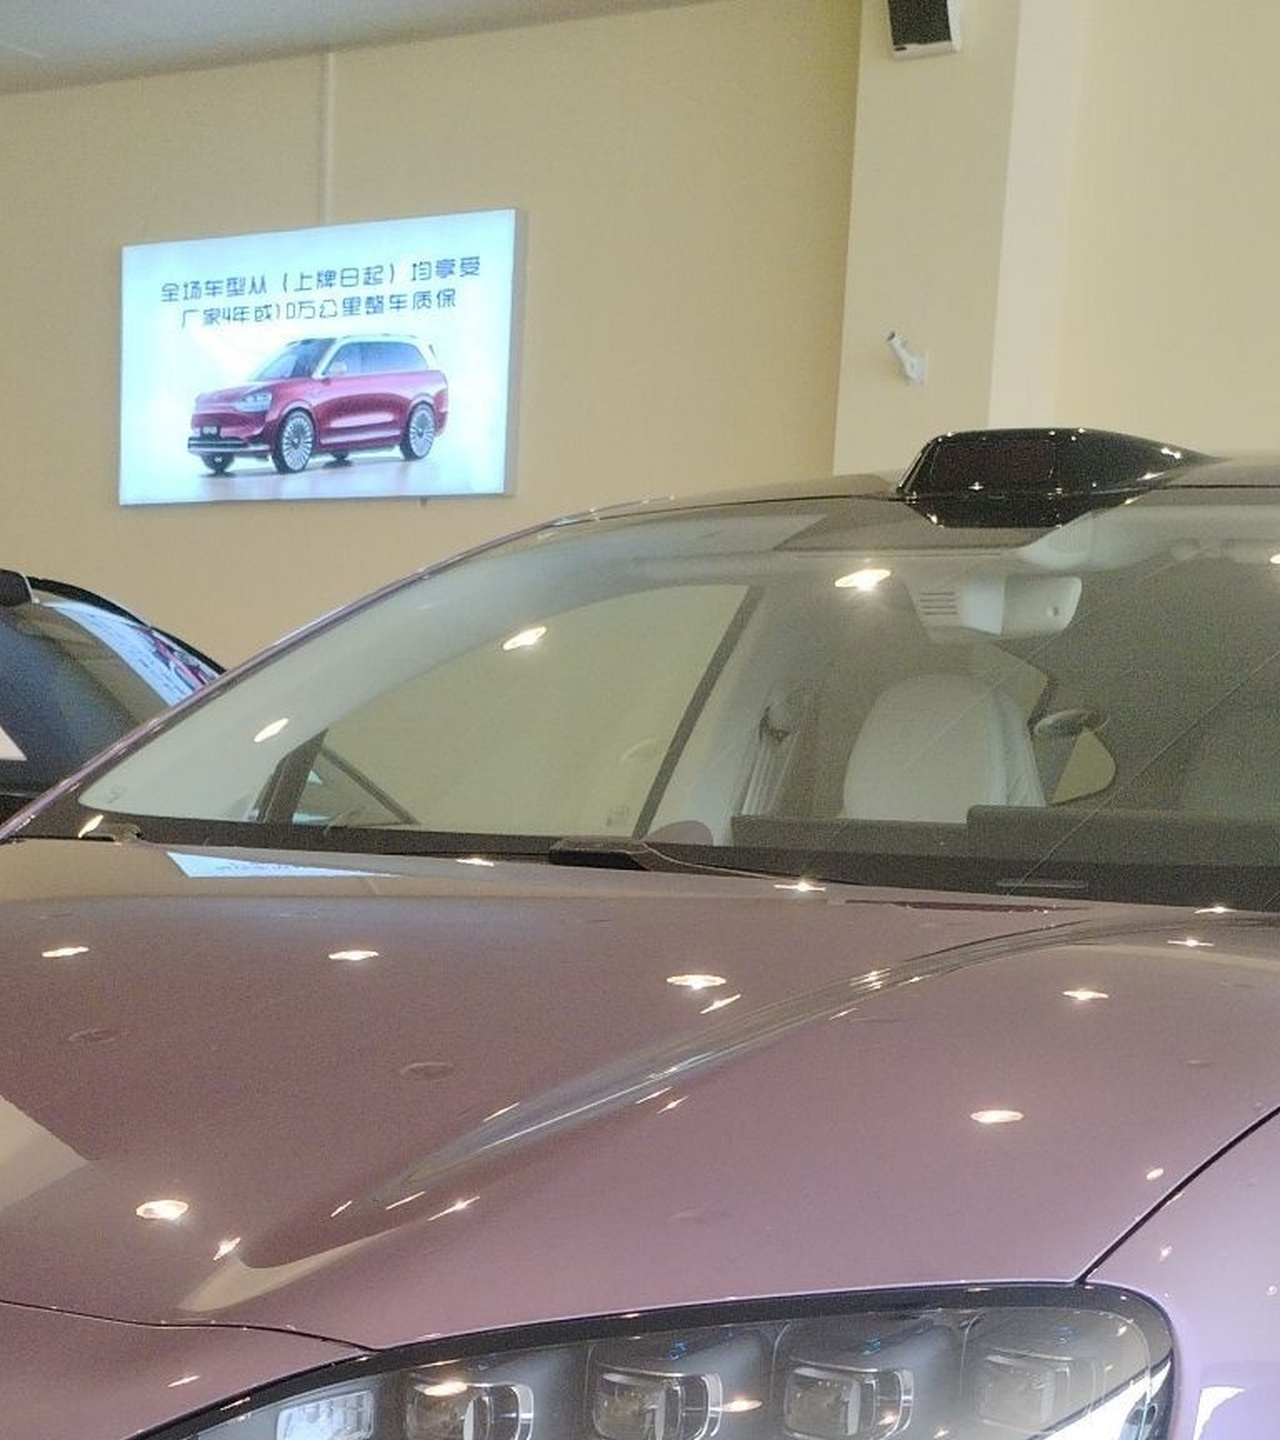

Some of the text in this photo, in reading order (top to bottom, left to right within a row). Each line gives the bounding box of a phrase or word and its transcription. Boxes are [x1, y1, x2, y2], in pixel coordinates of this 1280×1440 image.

[182, 288, 456, 329] 厂家4年或10万公里整车质保
